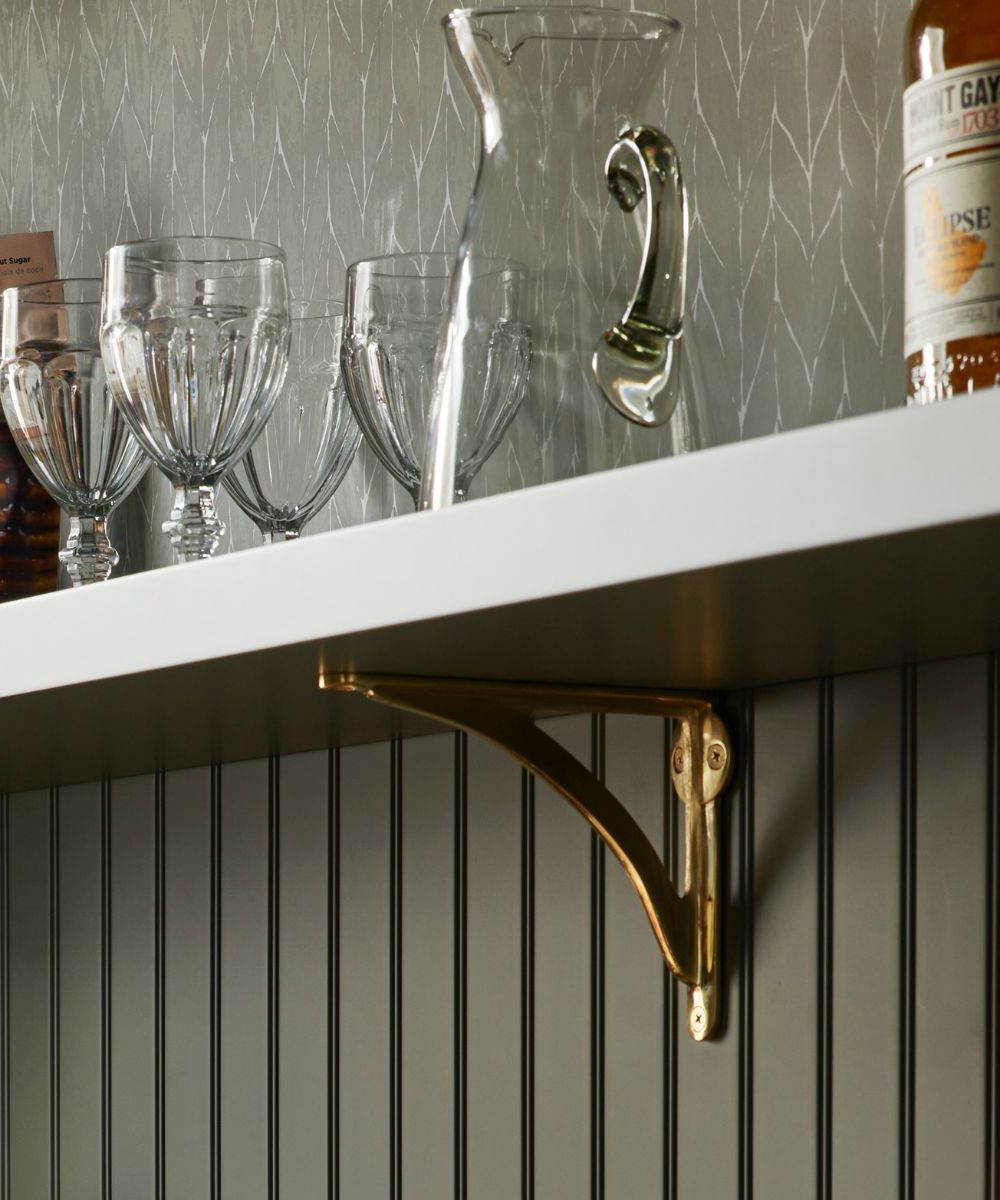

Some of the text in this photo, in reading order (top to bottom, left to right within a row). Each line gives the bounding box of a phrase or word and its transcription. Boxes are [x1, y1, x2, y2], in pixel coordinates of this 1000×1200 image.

[960, 75, 1000, 109] GAY
[961, 107, 1000, 134] 1703
[8, 256, 31, 265] Sugar
